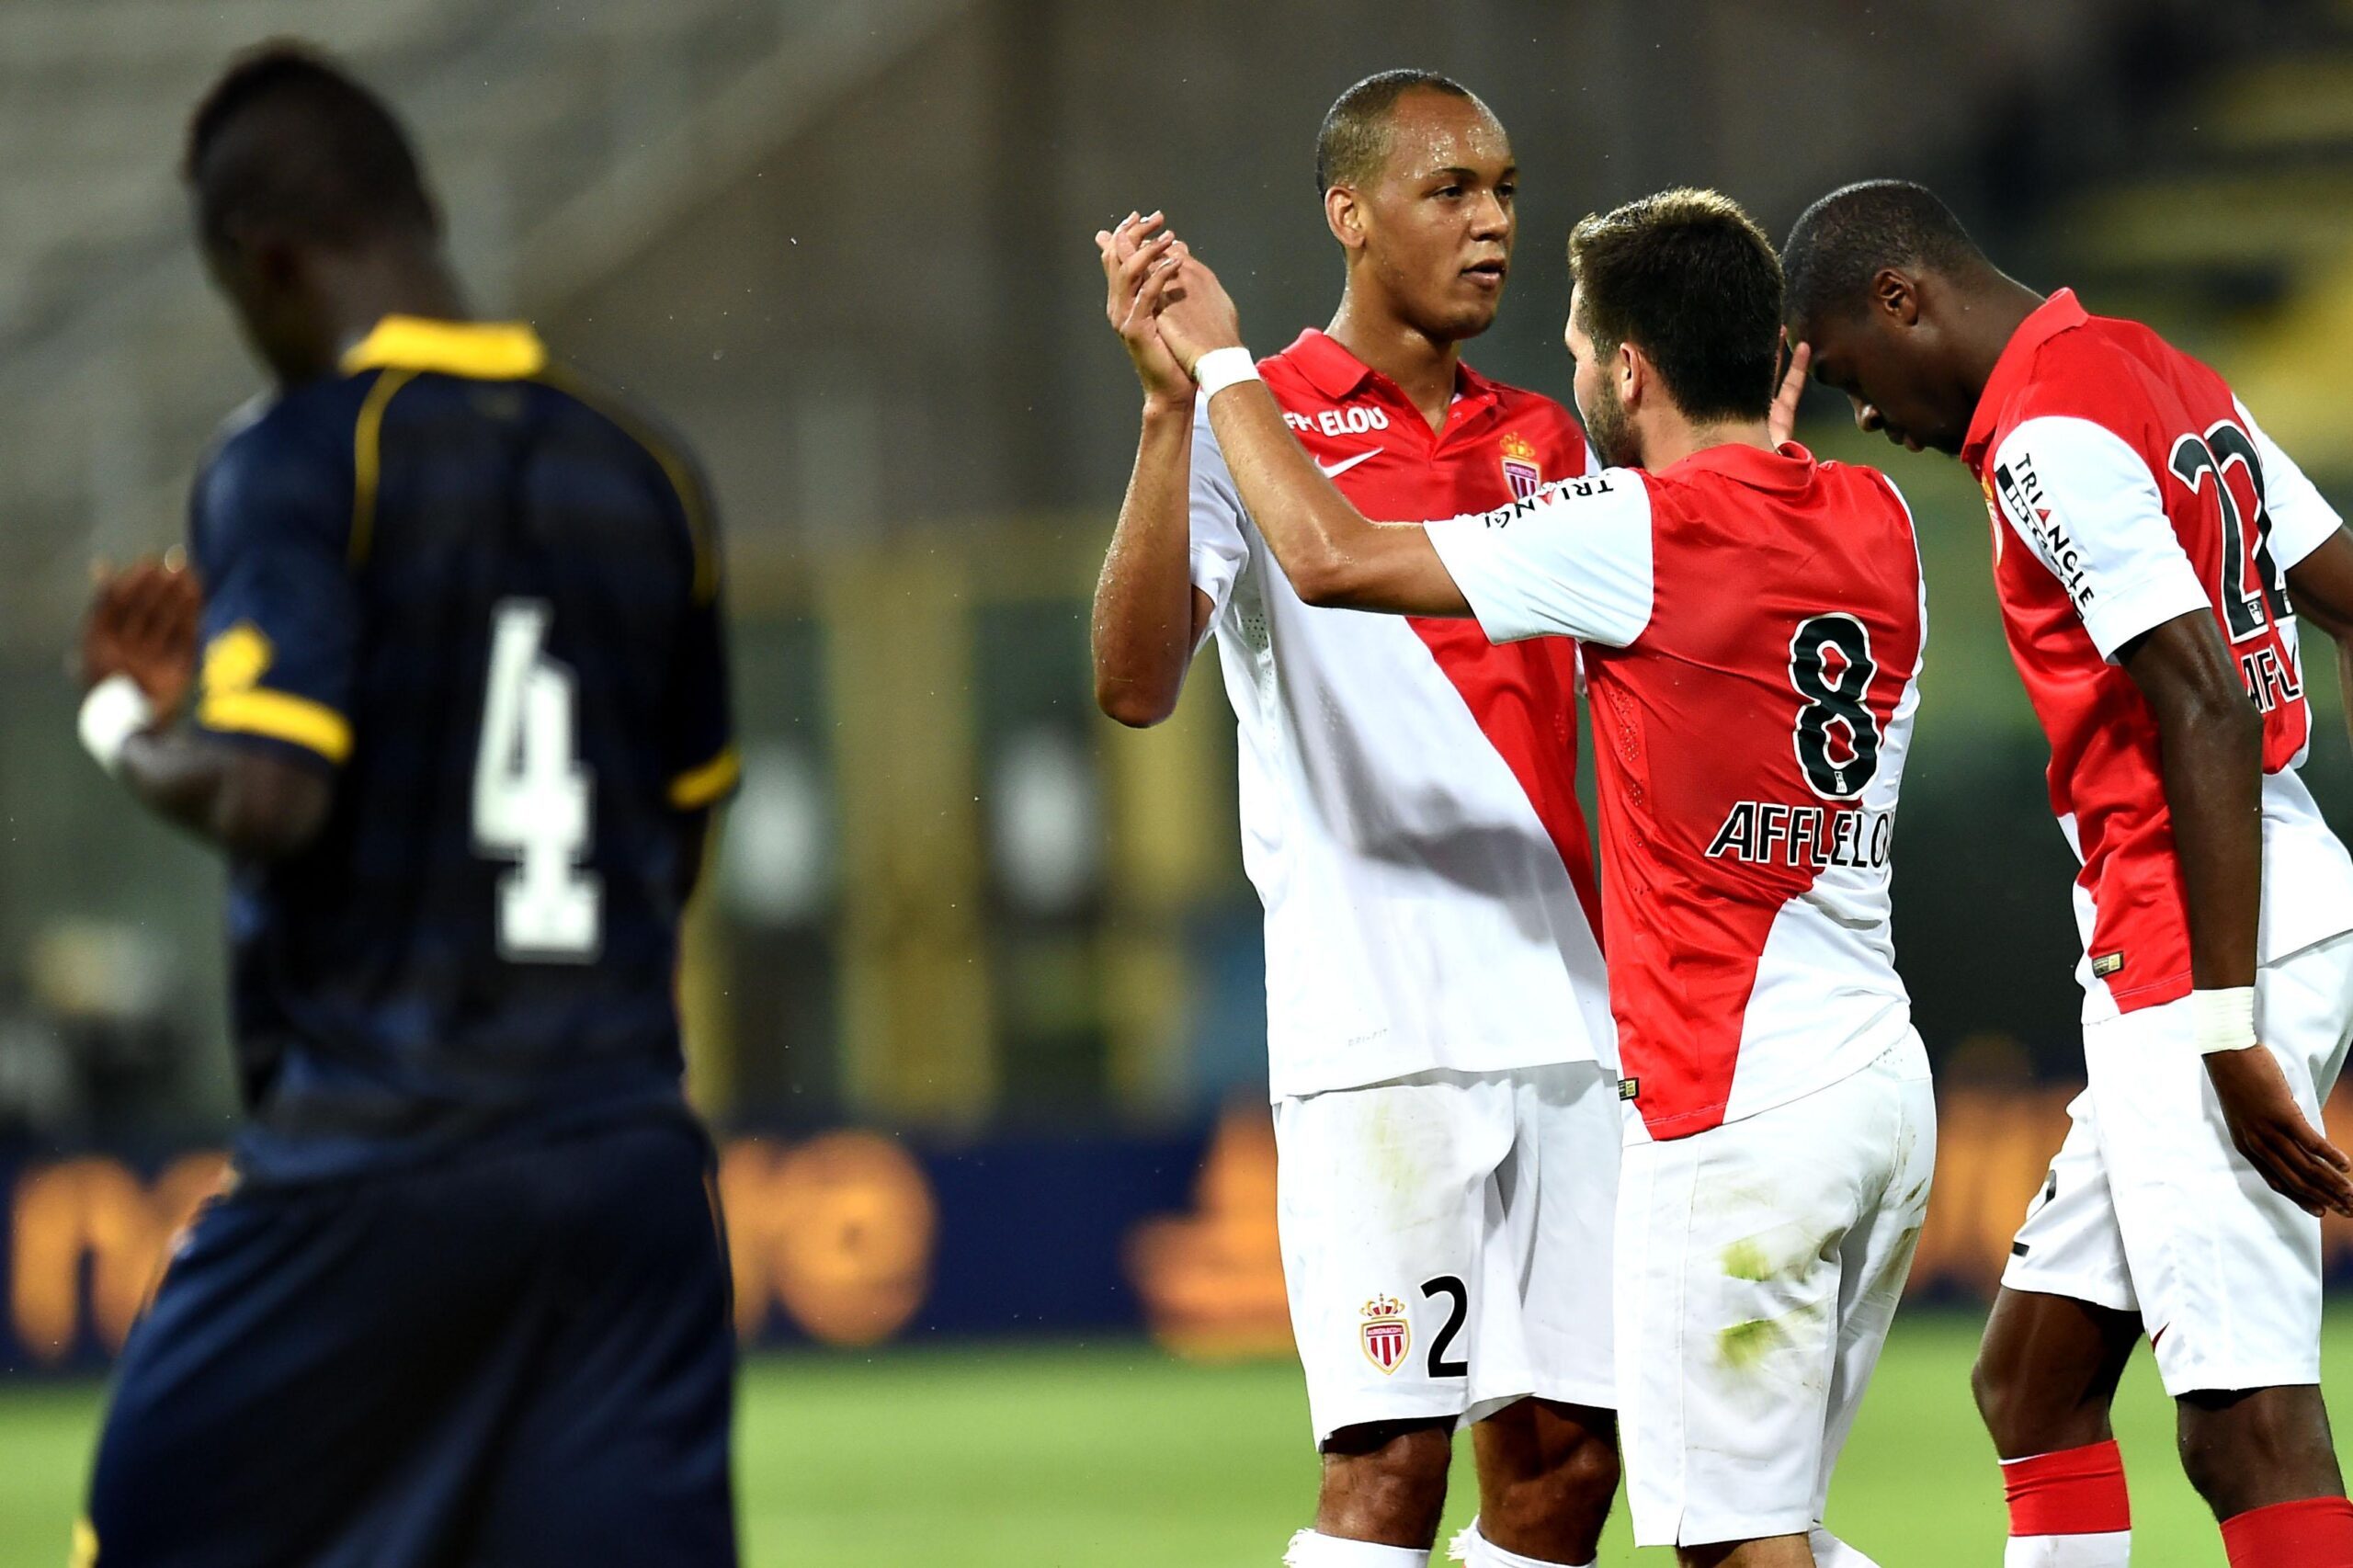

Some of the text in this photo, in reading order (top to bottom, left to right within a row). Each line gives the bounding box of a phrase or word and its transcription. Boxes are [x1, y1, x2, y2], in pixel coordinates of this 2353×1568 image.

[2168, 419, 2298, 645] 22
[469, 597, 603, 961] 4
[1789, 612, 1879, 801] 8
[1704, 801, 1896, 869] AFFLELO
[1420, 1275, 1470, 1380] 2
